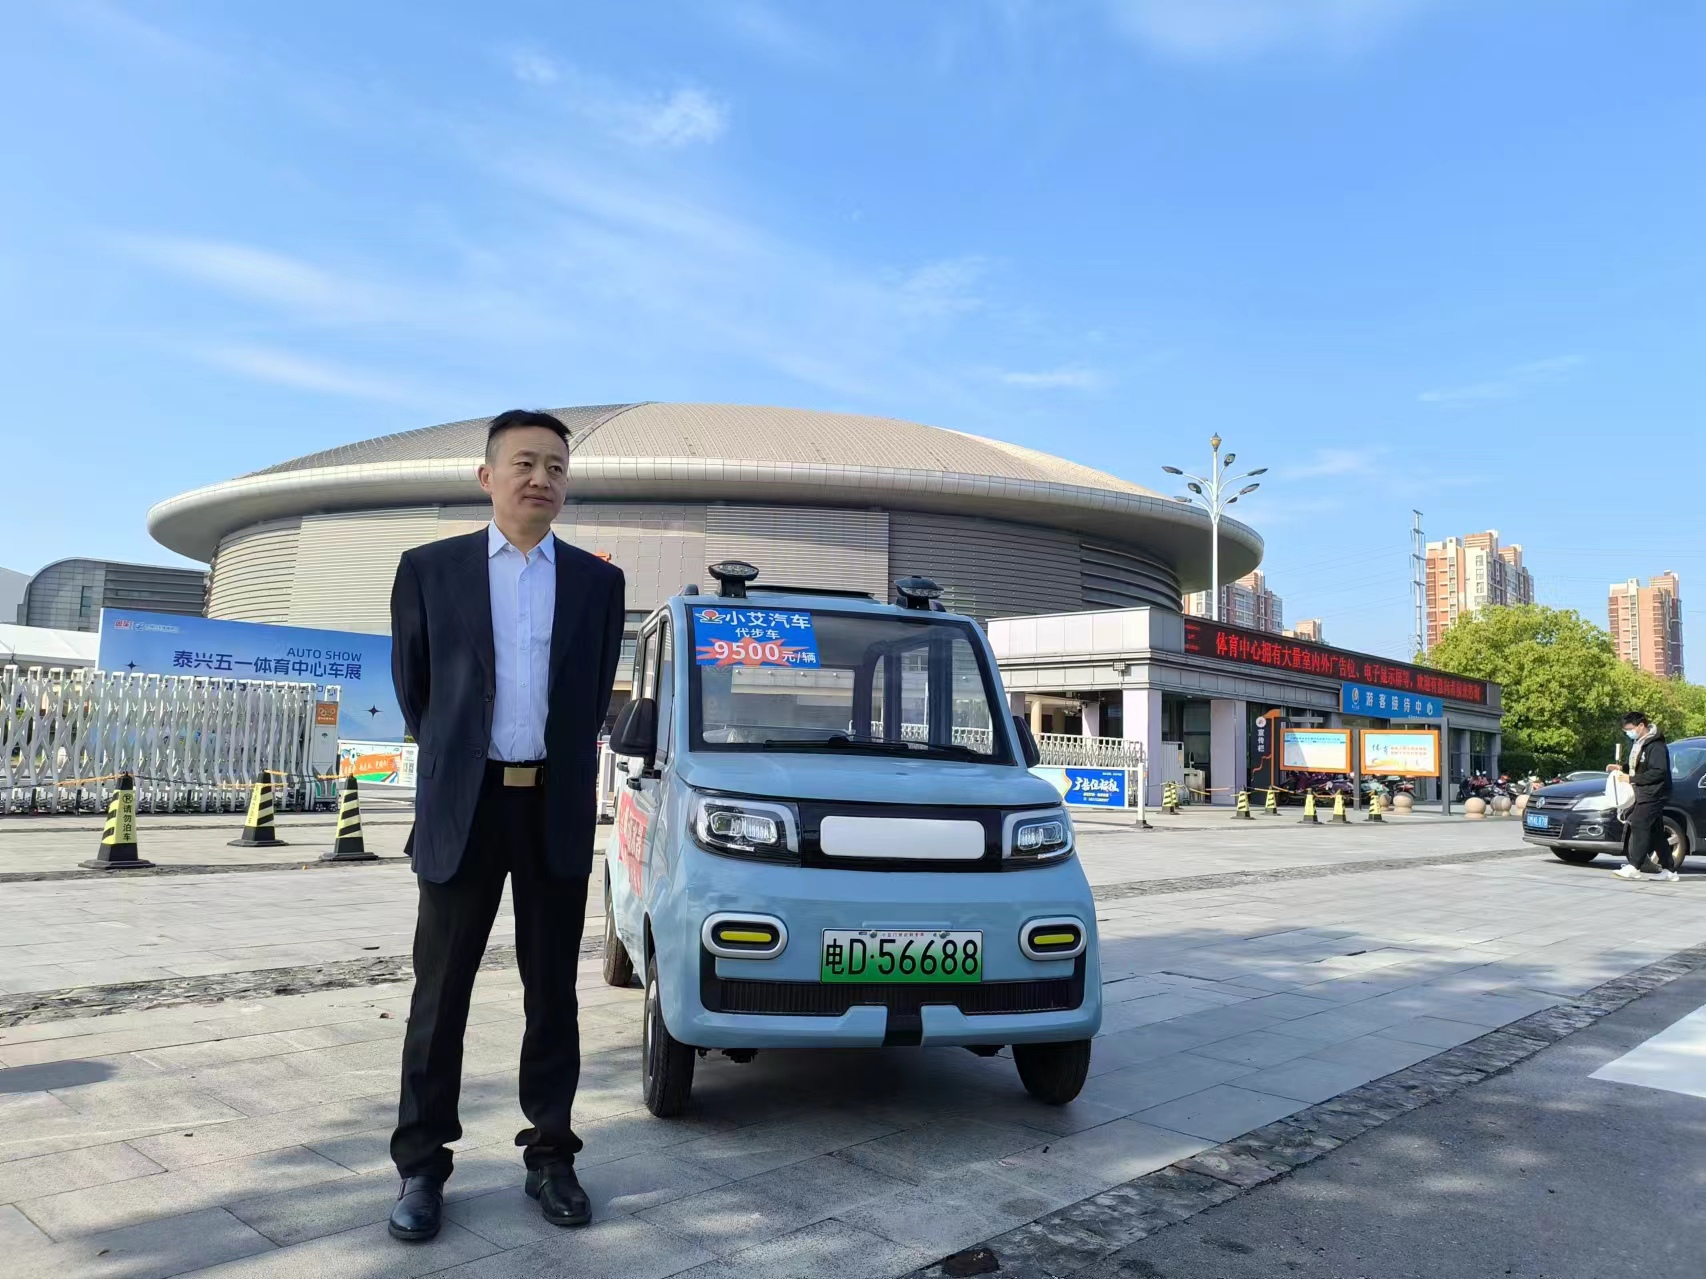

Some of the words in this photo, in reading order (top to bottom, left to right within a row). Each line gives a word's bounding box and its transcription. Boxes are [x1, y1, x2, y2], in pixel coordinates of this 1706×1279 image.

[725, 611, 811, 629] 小艾汽车
[735, 627, 780, 640] 代步车
[173, 649, 362, 680] 泰兴五一体育中心车展
[286, 647, 321, 659] AUTO
[325, 650, 362, 662] SHOW
[1366, 691, 1434, 717] 游客接待中心
[1257, 728, 1265, 753] 宣传栏
[122, 804, 132, 842] 请勿泊车
